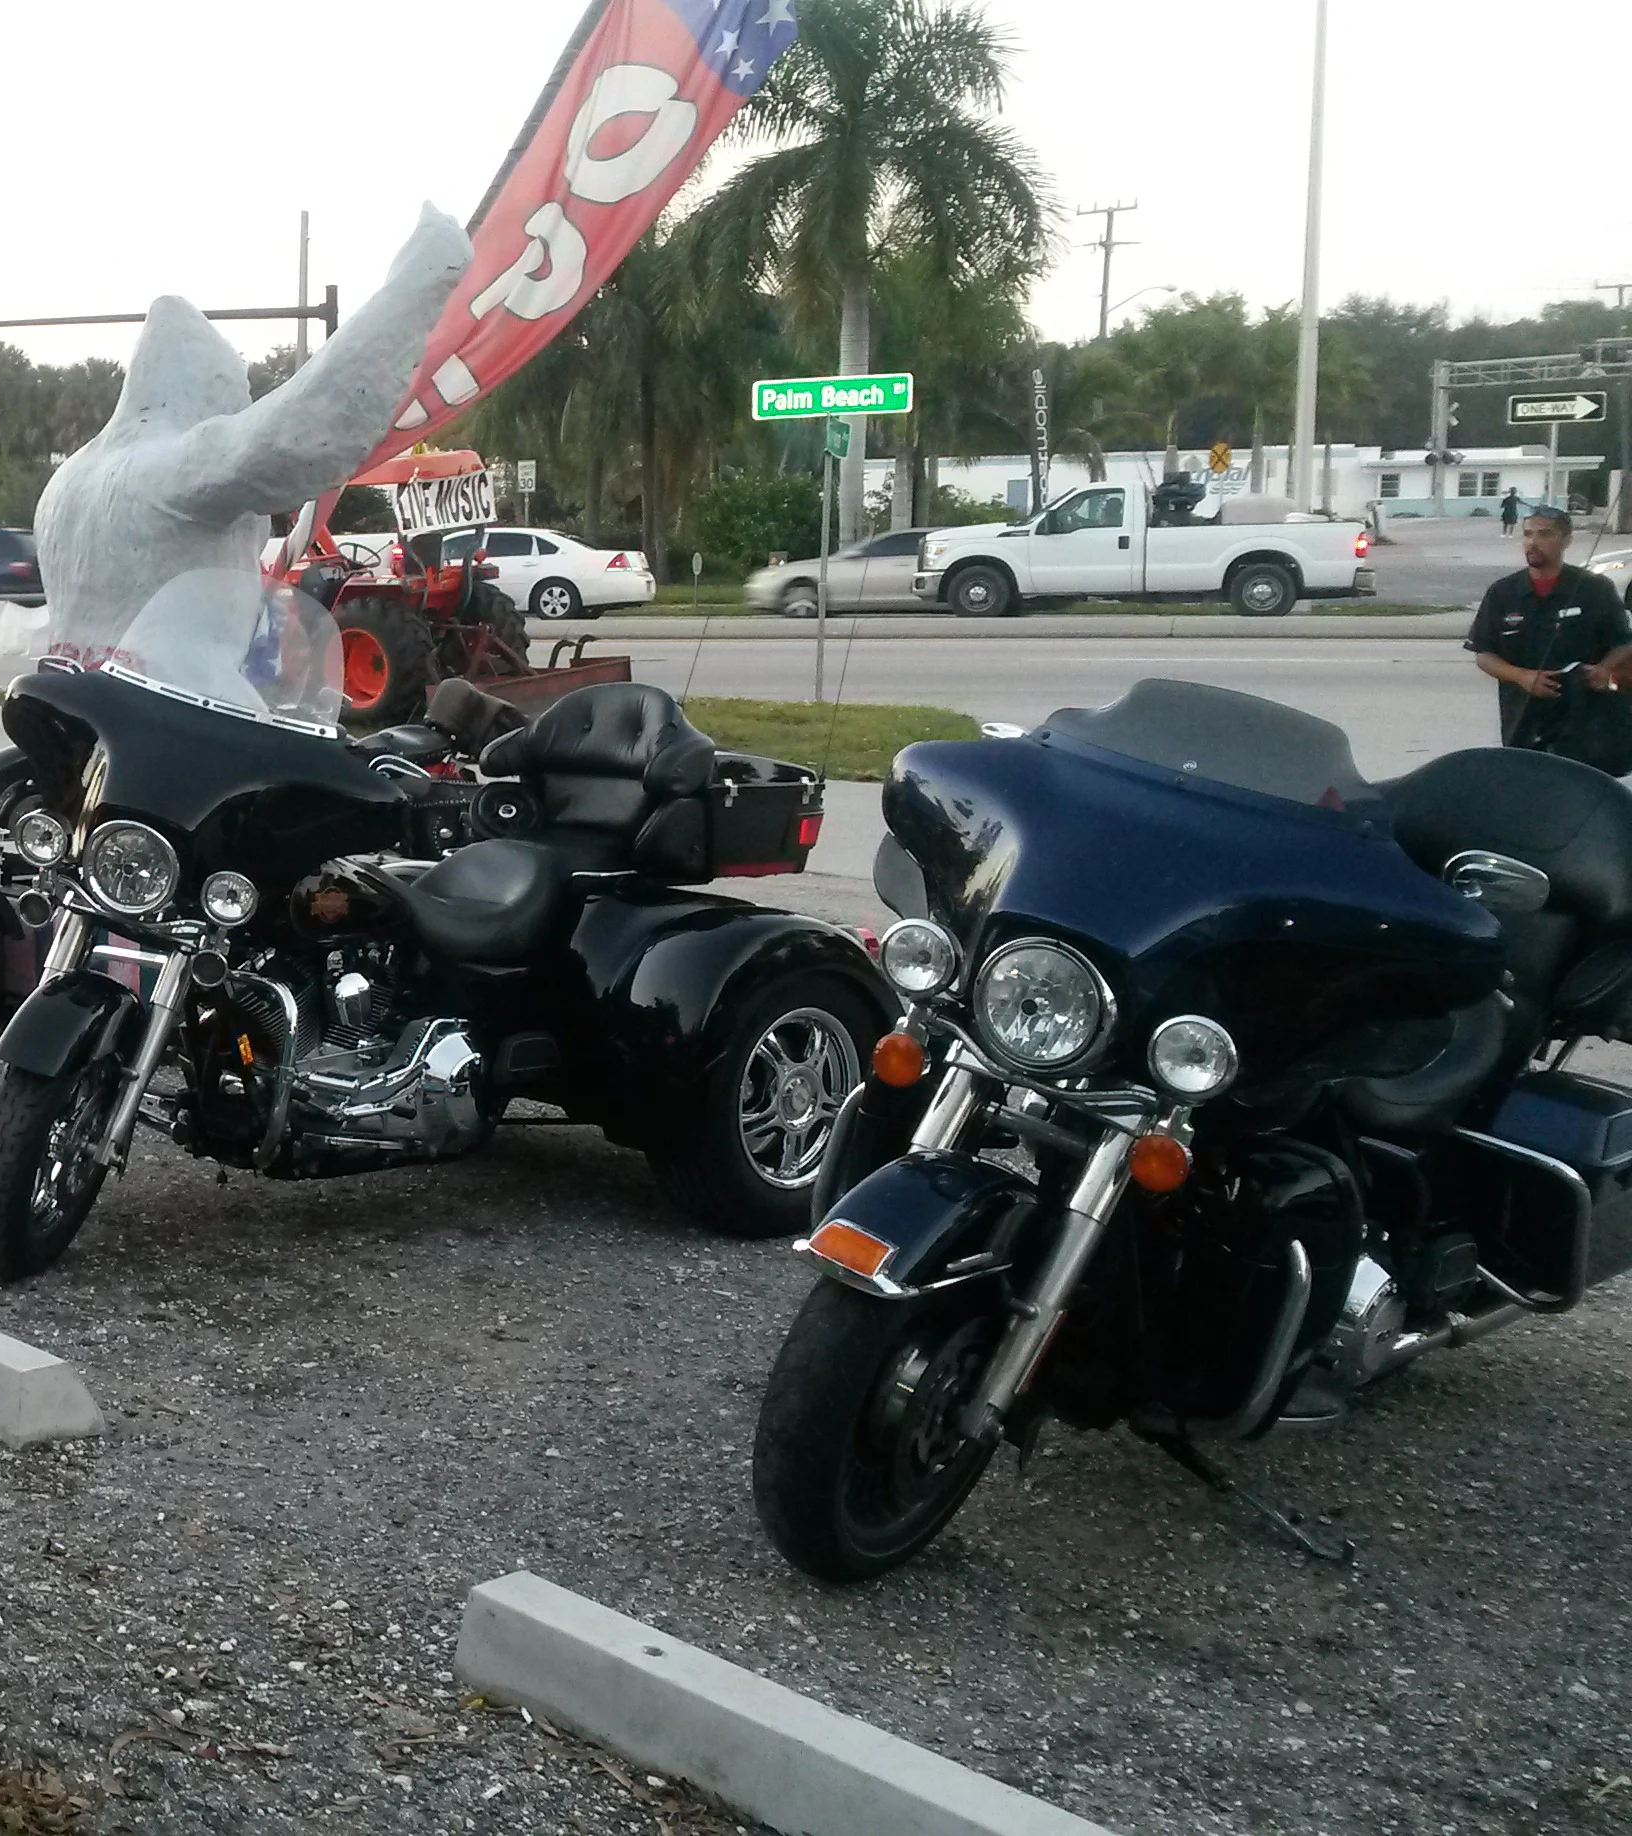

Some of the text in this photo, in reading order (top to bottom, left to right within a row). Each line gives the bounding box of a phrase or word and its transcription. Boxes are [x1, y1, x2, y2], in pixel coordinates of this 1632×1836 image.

[762, 388, 813, 411] Palm
[821, 384, 885, 408] Beach
[520, 478, 533, 489] 30
[399, 472, 491, 530] LIVE MUSIC
